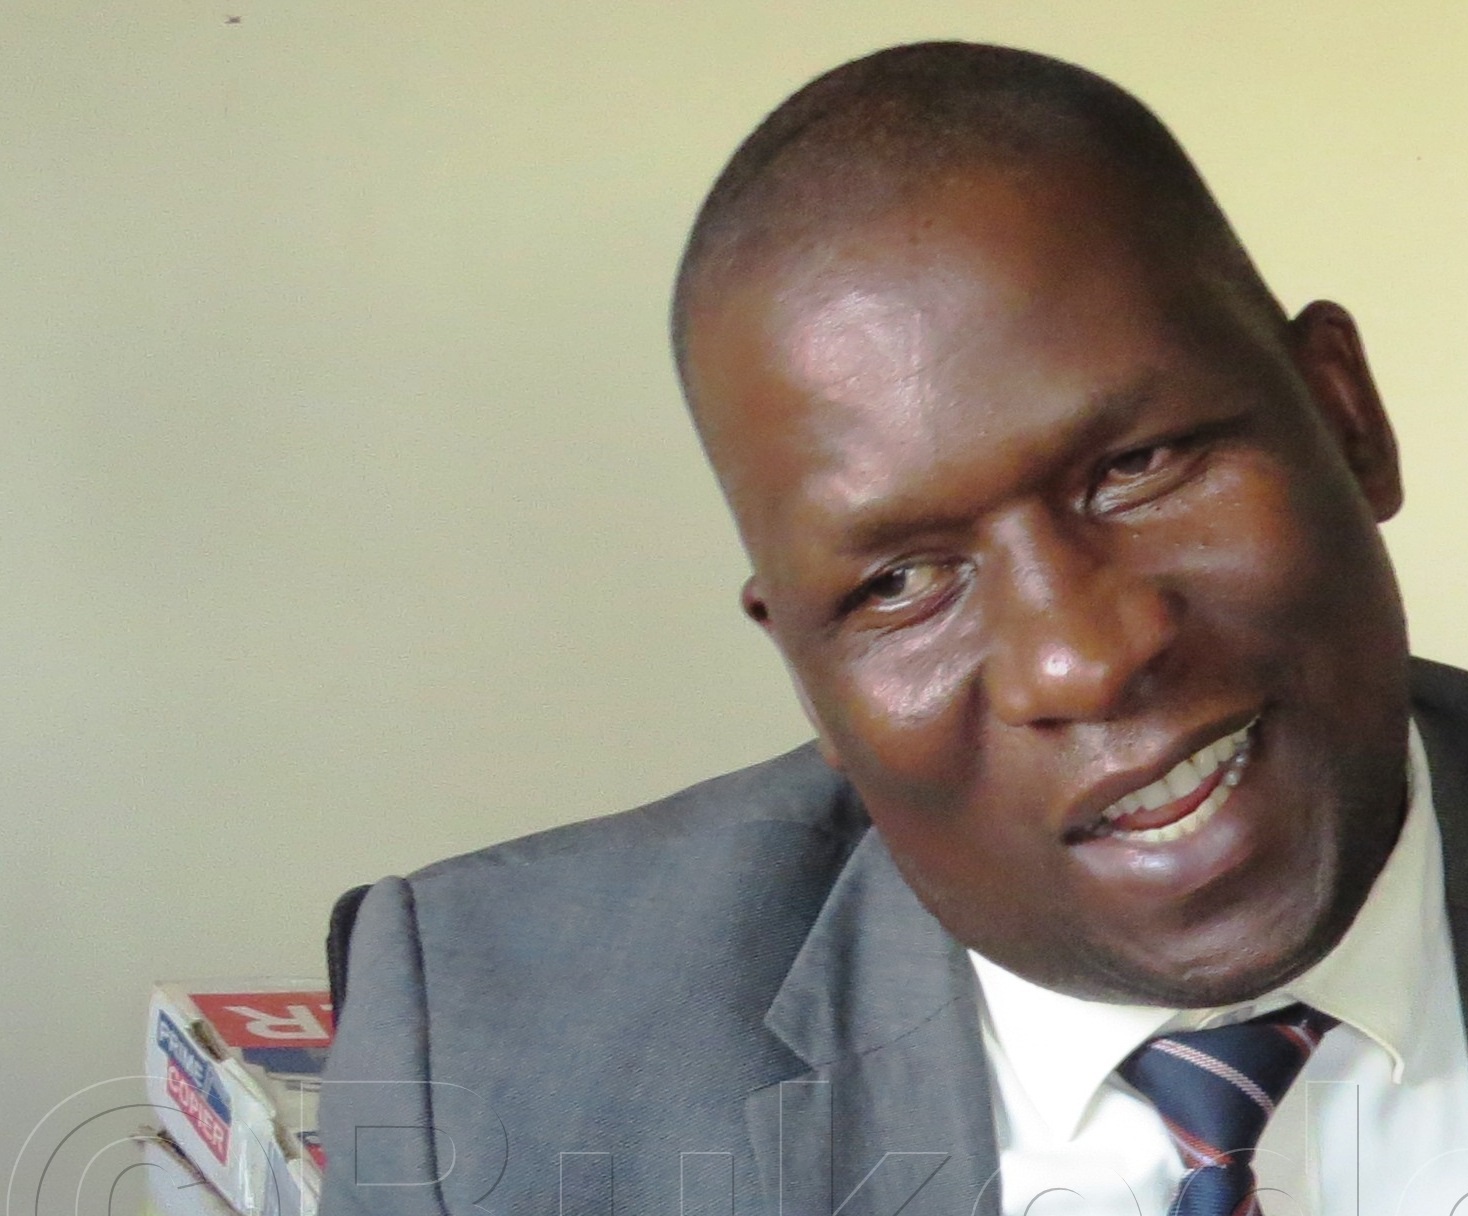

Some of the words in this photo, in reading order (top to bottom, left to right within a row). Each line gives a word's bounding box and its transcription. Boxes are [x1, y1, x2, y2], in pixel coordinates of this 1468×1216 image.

[158, 1020, 206, 1088] PRIME
[222, 1004, 334, 1040] R
[168, 1064, 225, 1149] COPIER
